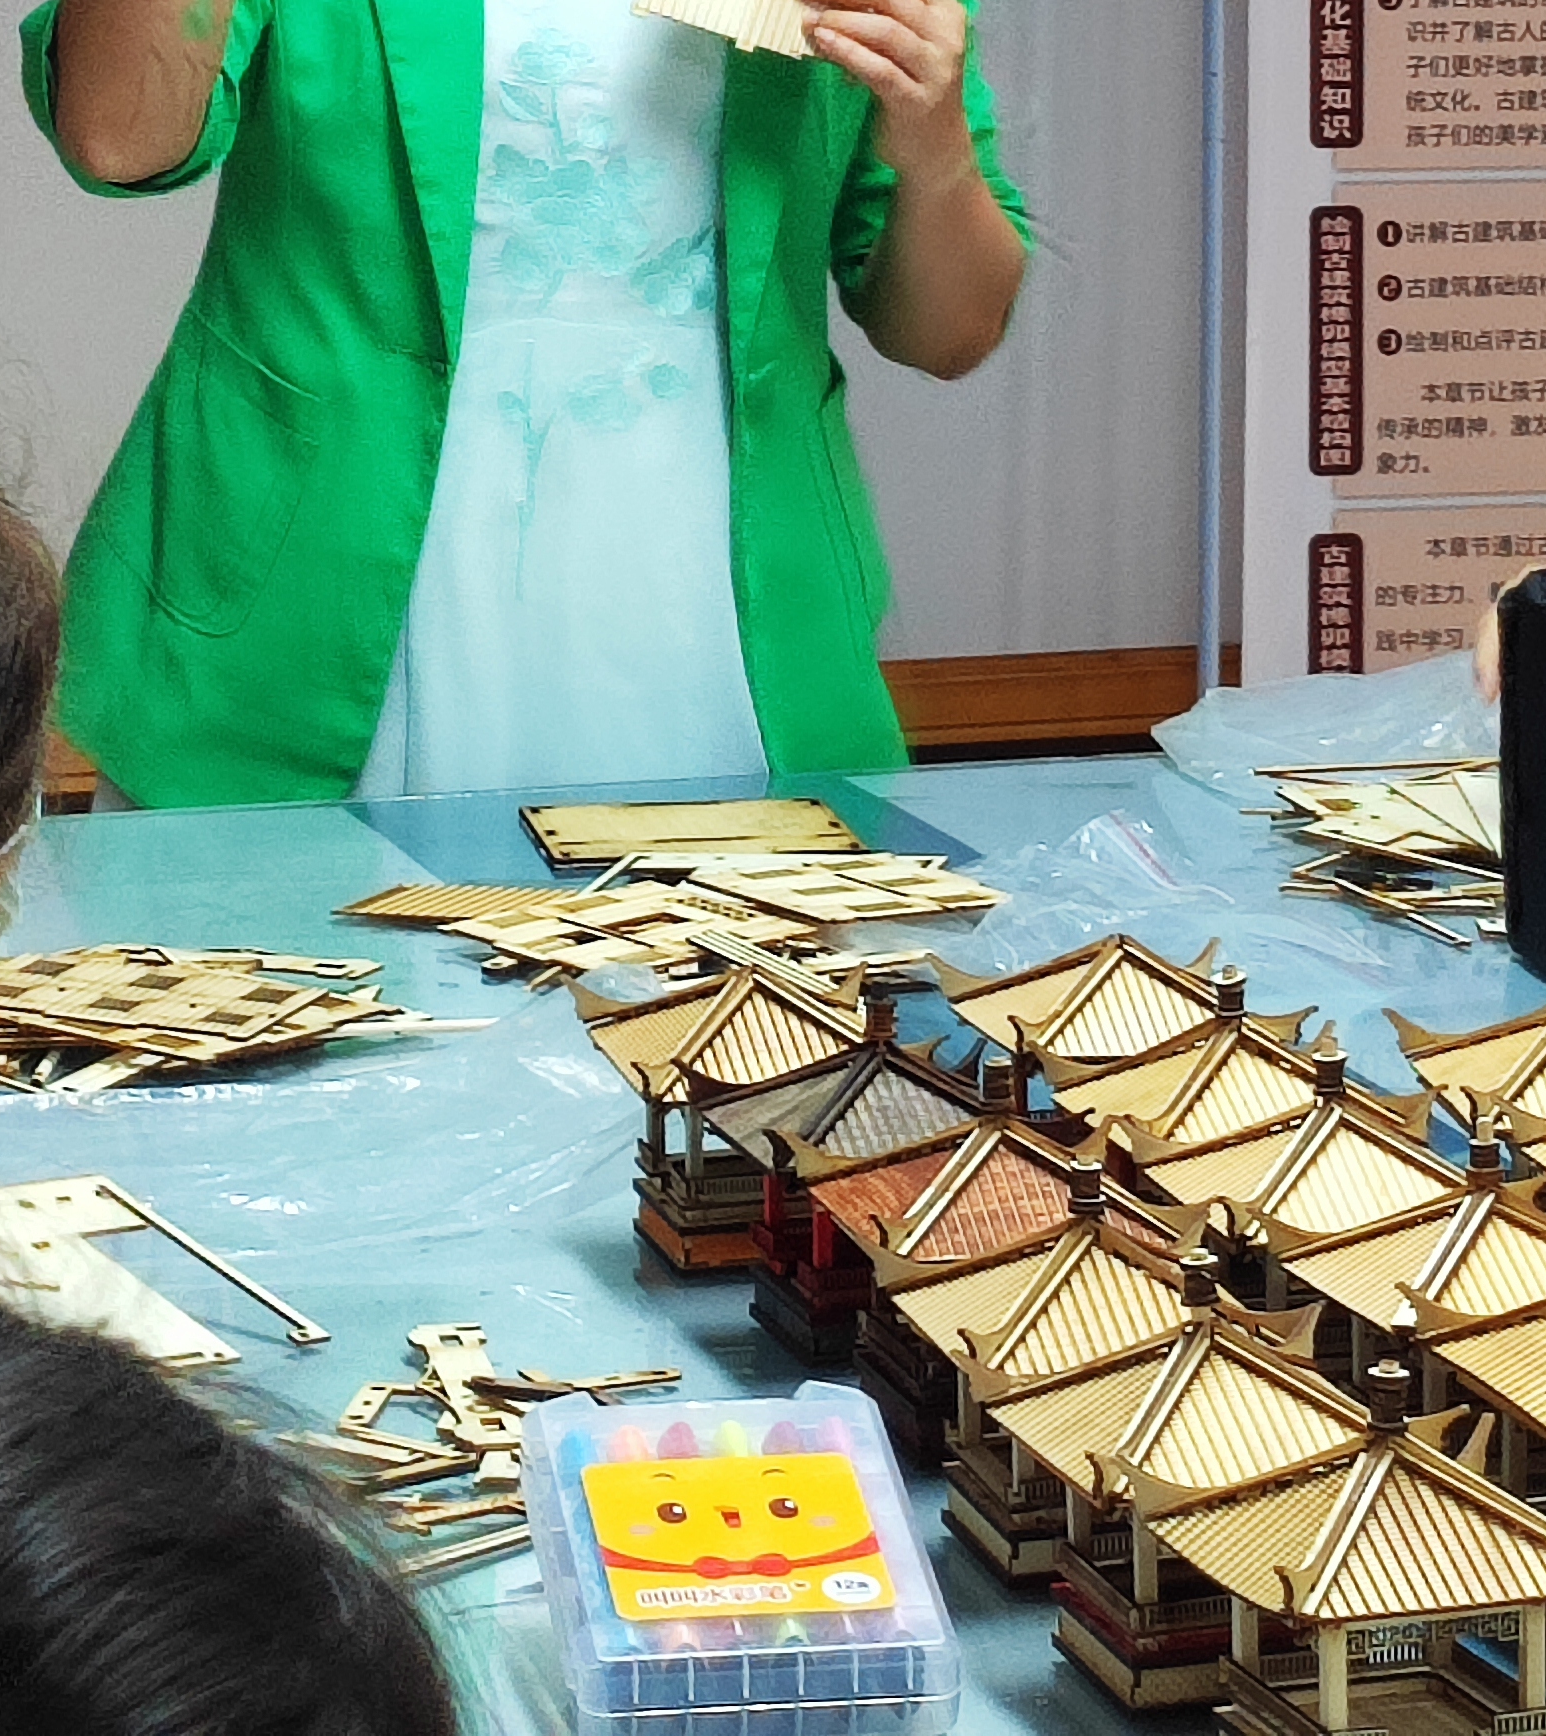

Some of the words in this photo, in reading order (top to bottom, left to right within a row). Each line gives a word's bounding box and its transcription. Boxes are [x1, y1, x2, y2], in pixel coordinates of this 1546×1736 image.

[1318, 545, 1353, 674] 古建筑榫卯模
